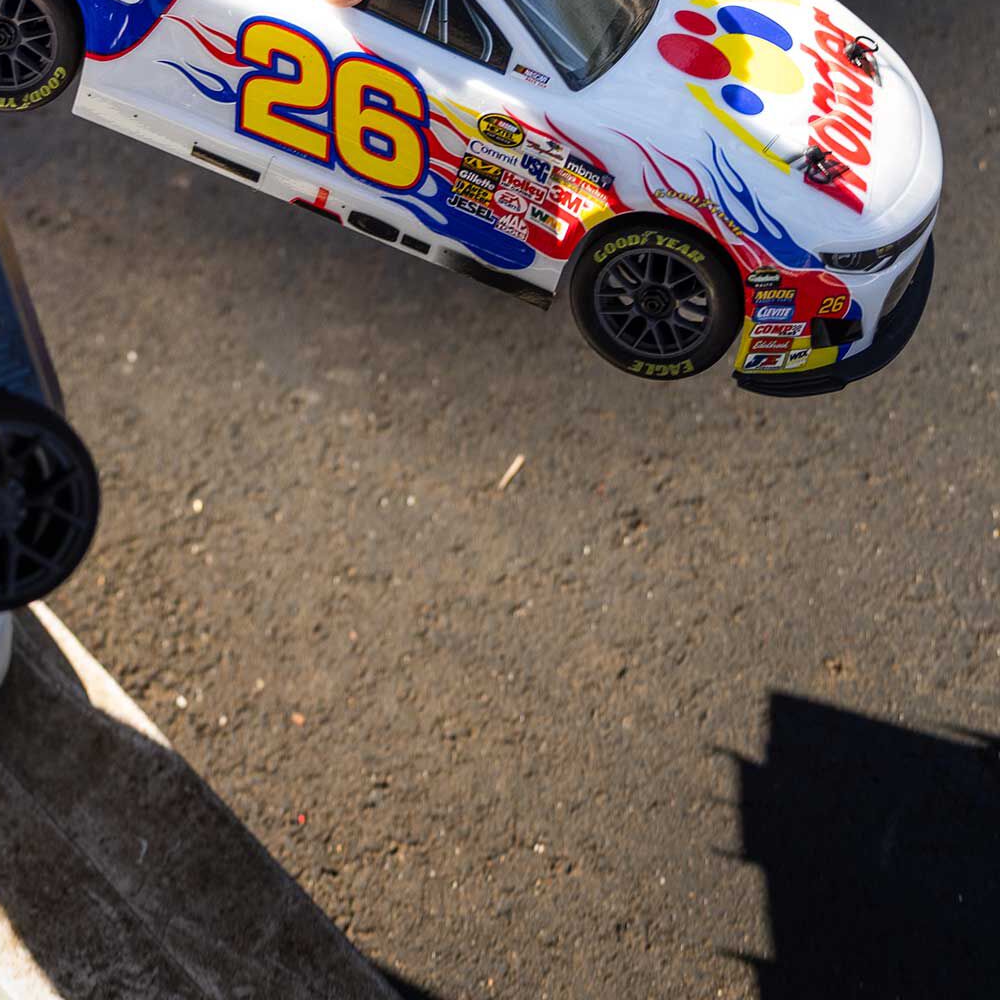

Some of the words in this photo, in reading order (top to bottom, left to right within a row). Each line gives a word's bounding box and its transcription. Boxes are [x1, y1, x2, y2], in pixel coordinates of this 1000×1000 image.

[235, 15, 429, 196] 26
[800, 6, 883, 216] wonder
[470, 140, 519, 166] Commit
[459, 170, 496, 191] Gillette
[521, 153, 551, 184] USG
[567, 161, 600, 183] mbna
[502, 171, 546, 201] Holley
[448, 195, 496, 223] JESEL
[500, 191, 521, 210] EA
[549, 185, 582, 213] 3M
[755, 289, 796, 300] MOOG
[818, 296, 847, 314] 26
[754, 325, 792, 336] COMP
[627, 358, 695, 377] EAGLE
